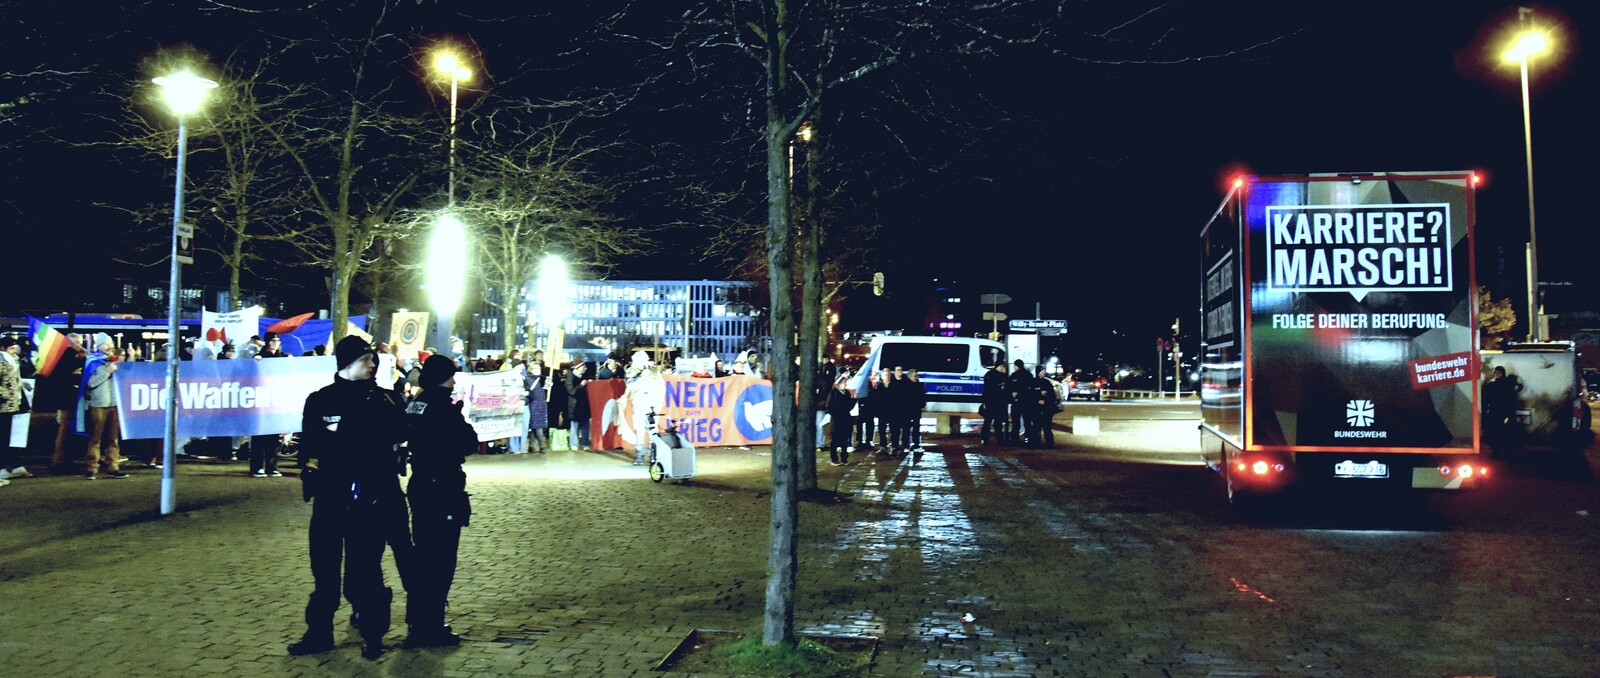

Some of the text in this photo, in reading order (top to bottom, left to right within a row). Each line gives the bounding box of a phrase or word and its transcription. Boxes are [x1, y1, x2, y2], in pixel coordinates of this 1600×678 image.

[1274, 211, 1443, 245] KARRIERE?
[1274, 247, 1443, 286] MARSCH!
[1012, 320, 1065, 328] Willy-Brandt-Platz
[1273, 313, 1450, 329] FOLGE DEINER BERUFUNG.
[1415, 356, 1468, 373] bundeswehr
[1417, 368, 1465, 383] karriere.de
[665, 381, 726, 408] NEIN
[1334, 430, 1387, 438] BUNDESWEHR
